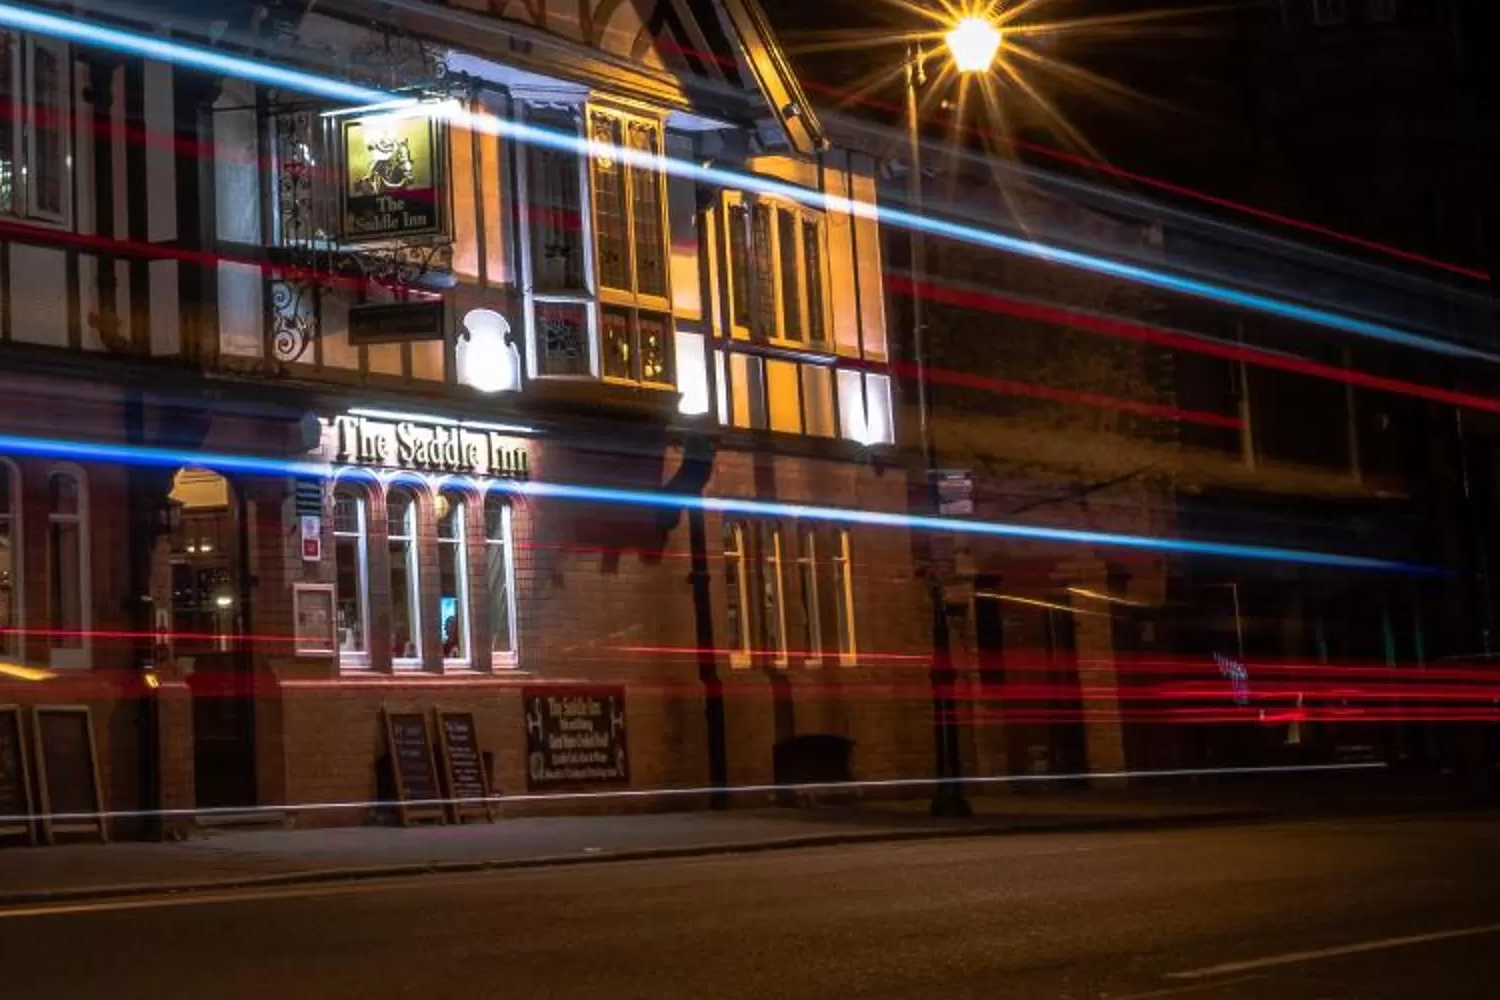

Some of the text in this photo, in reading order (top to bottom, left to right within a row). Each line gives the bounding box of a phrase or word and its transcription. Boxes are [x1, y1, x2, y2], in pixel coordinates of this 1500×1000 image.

[376, 194, 405, 213] The
[403, 211, 428, 228] Inn
[335, 415, 530, 474] The Saddle Inn
